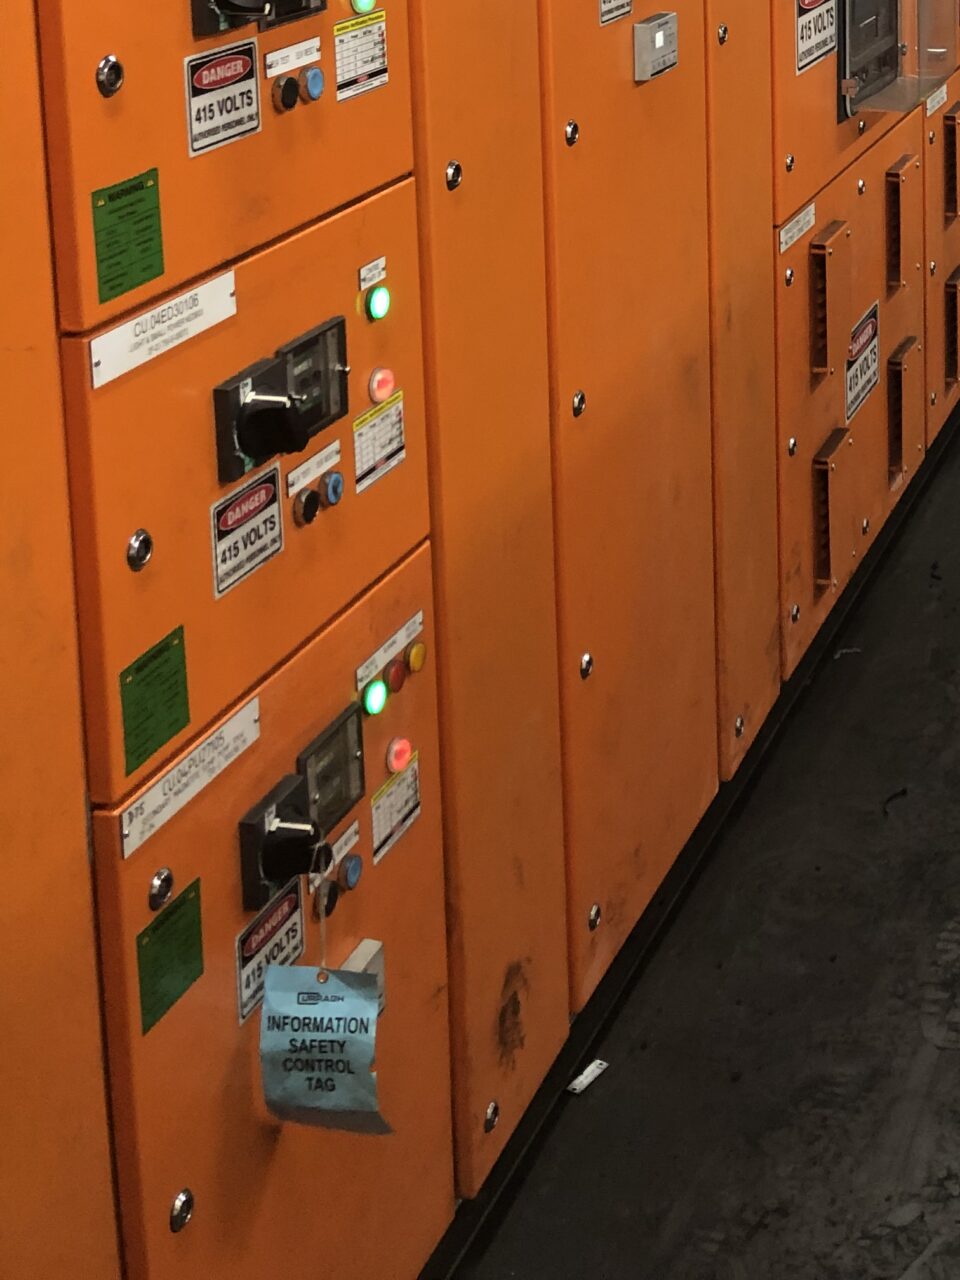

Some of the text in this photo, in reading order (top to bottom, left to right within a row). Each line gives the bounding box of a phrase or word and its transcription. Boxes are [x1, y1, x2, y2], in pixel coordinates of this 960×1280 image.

[800, 7, 834, 43] 415 VOLTS
[201, 59, 243, 85] DANGER
[195, 88, 253, 125] 415 VOLTS
[226, 486, 266, 527] DANGER
[220, 512, 275, 567] 415 VOLTS
[251, 899, 289, 949] DANGER
[245, 920, 297, 992] 415 VOLTS
[267, 1015, 370, 1034] INFORMATION
[288, 1038, 346, 1054] SAFETY
[282, 1058, 355, 1074] CONTROL
[305, 1076, 336, 1092] TAG
